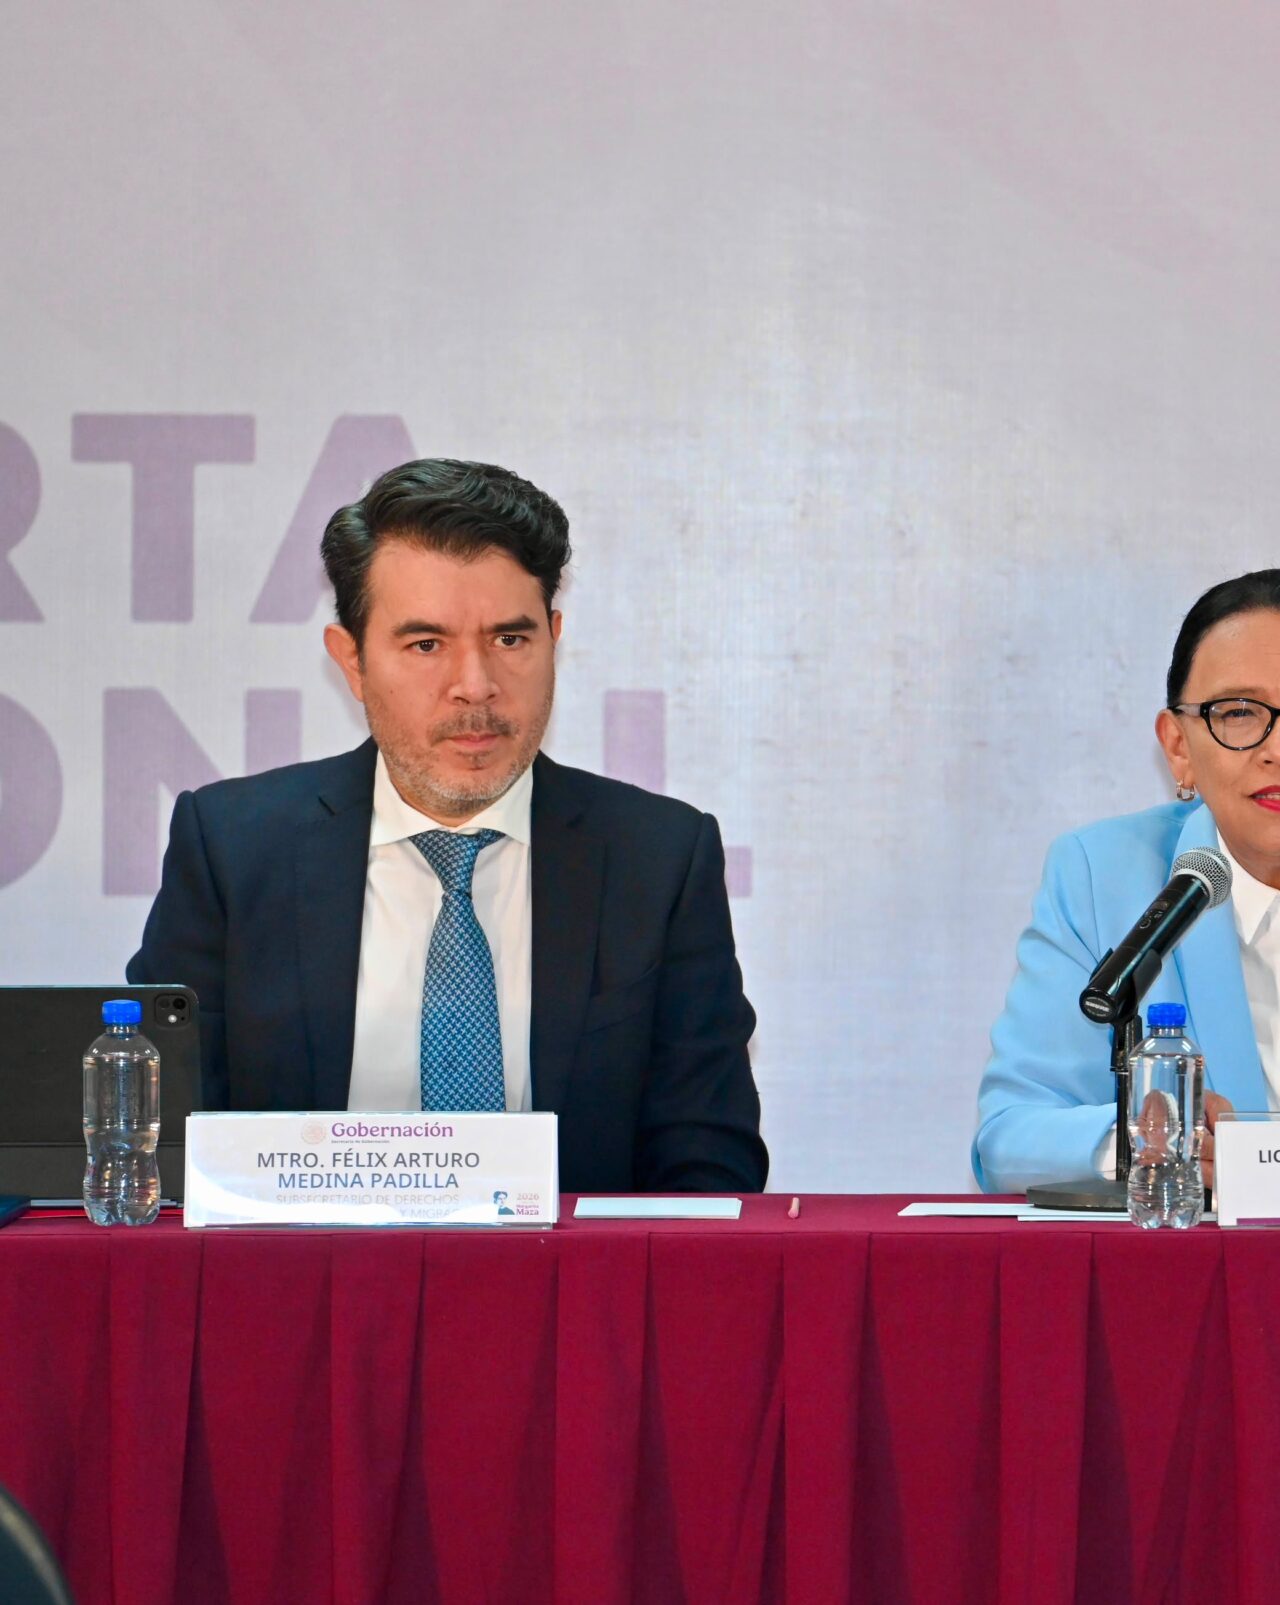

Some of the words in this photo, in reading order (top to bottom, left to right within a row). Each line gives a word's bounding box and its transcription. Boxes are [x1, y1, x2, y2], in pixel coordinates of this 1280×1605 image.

[331, 1122, 454, 1138] Gobernación
[257, 1151, 325, 1168] MTRO.
[332, 1148, 387, 1168] FÉLIX
[393, 1151, 480, 1168] ARTURO
[278, 1172, 364, 1189] MEDINA
[371, 1172, 460, 1189] PADILLA
[394, 1193, 460, 1205] DERECHOS
[516, 1193, 540, 1201] 2026
